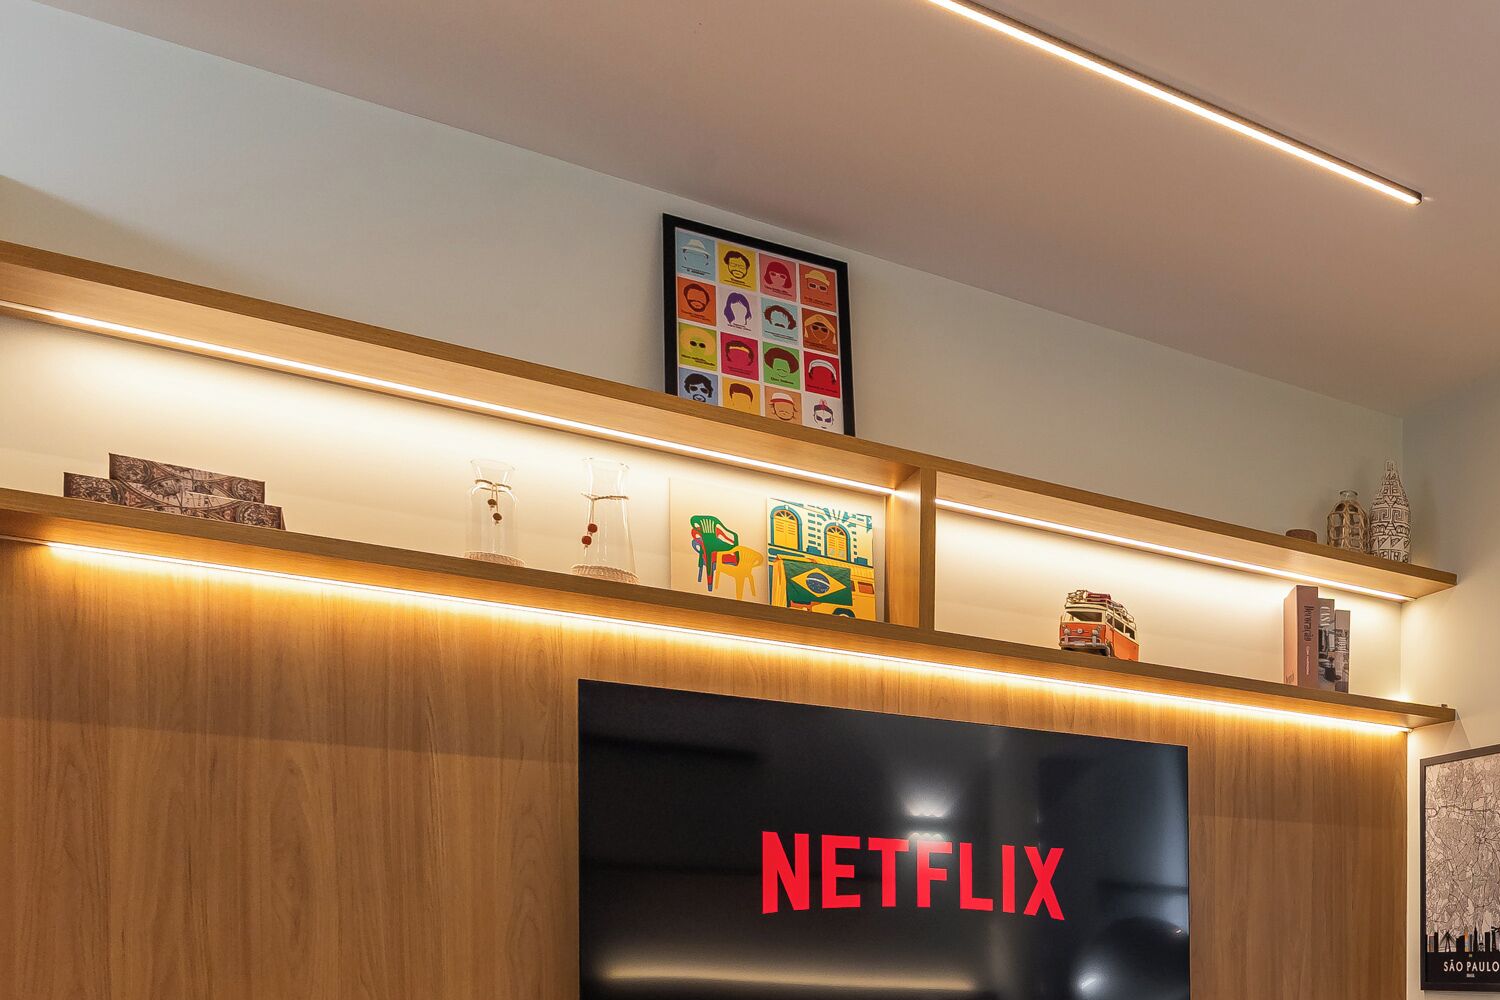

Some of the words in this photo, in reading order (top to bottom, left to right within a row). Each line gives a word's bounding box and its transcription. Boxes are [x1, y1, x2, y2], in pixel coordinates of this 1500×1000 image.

[1321, 606, 1331, 627] CASA
[761, 831, 1065, 921] NETFLIX
[1443, 959, 1463, 972] SÃO
[1466, 961, 1500, 972] PAULO
